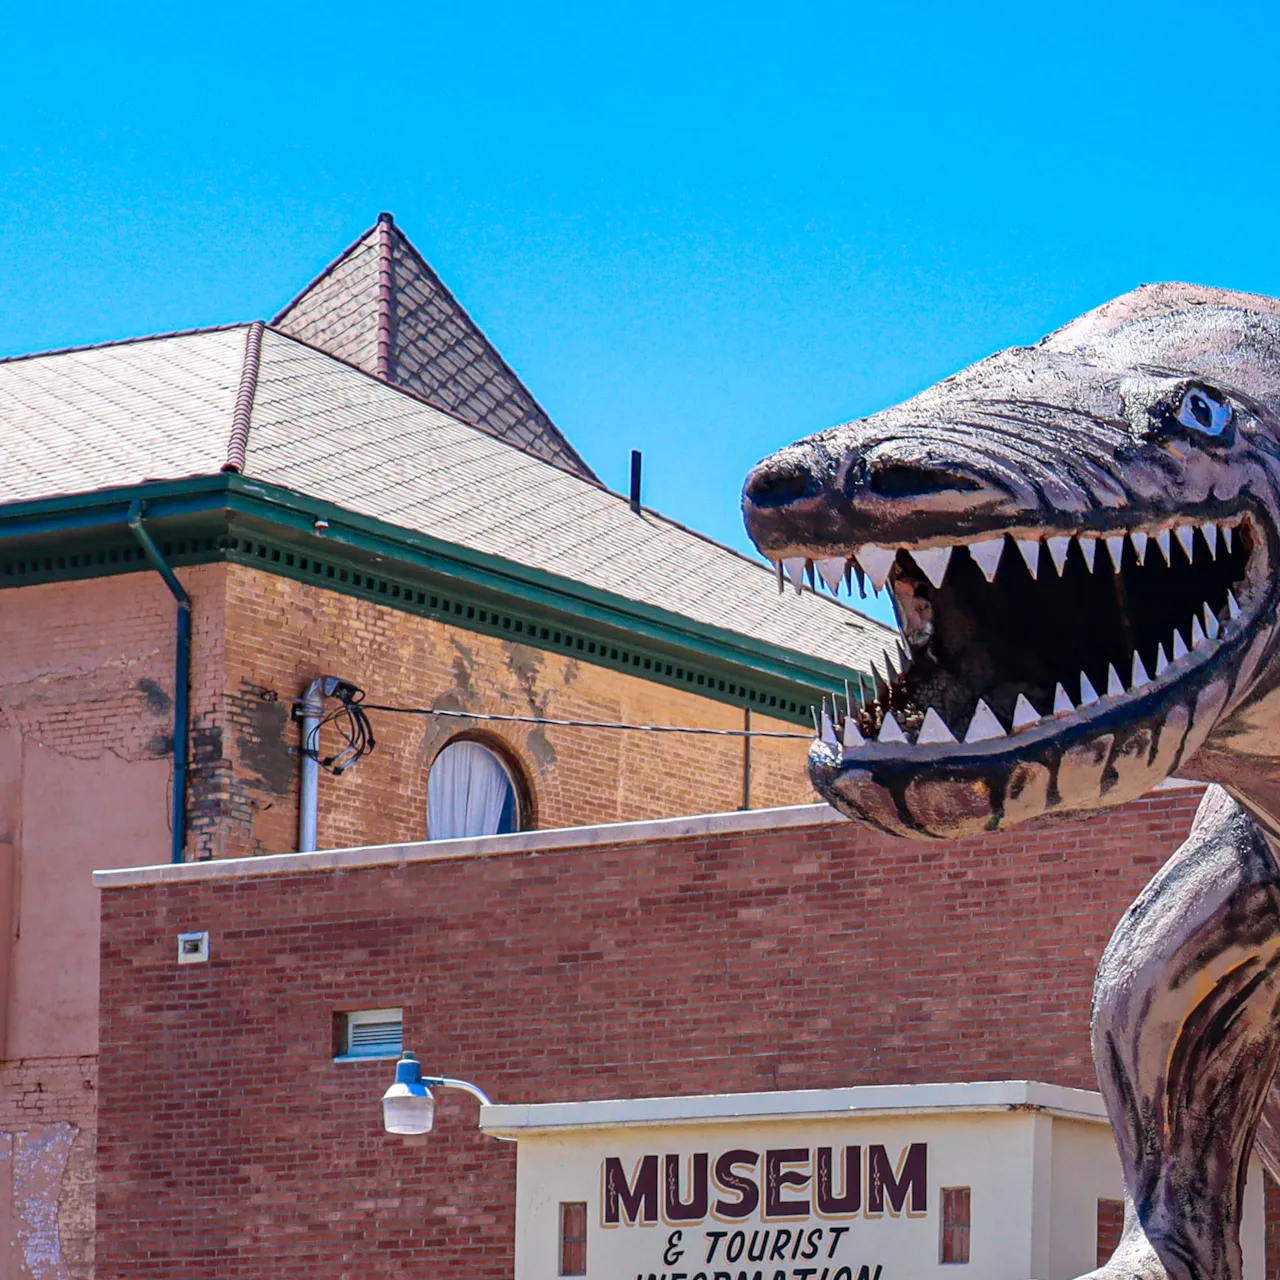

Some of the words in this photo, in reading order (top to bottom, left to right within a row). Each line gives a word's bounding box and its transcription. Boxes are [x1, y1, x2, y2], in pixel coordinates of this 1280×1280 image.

[603, 1142, 928, 1226] MUSEUM
[663, 1230, 685, 1266] &
[705, 1226, 850, 1264] TOURIST
